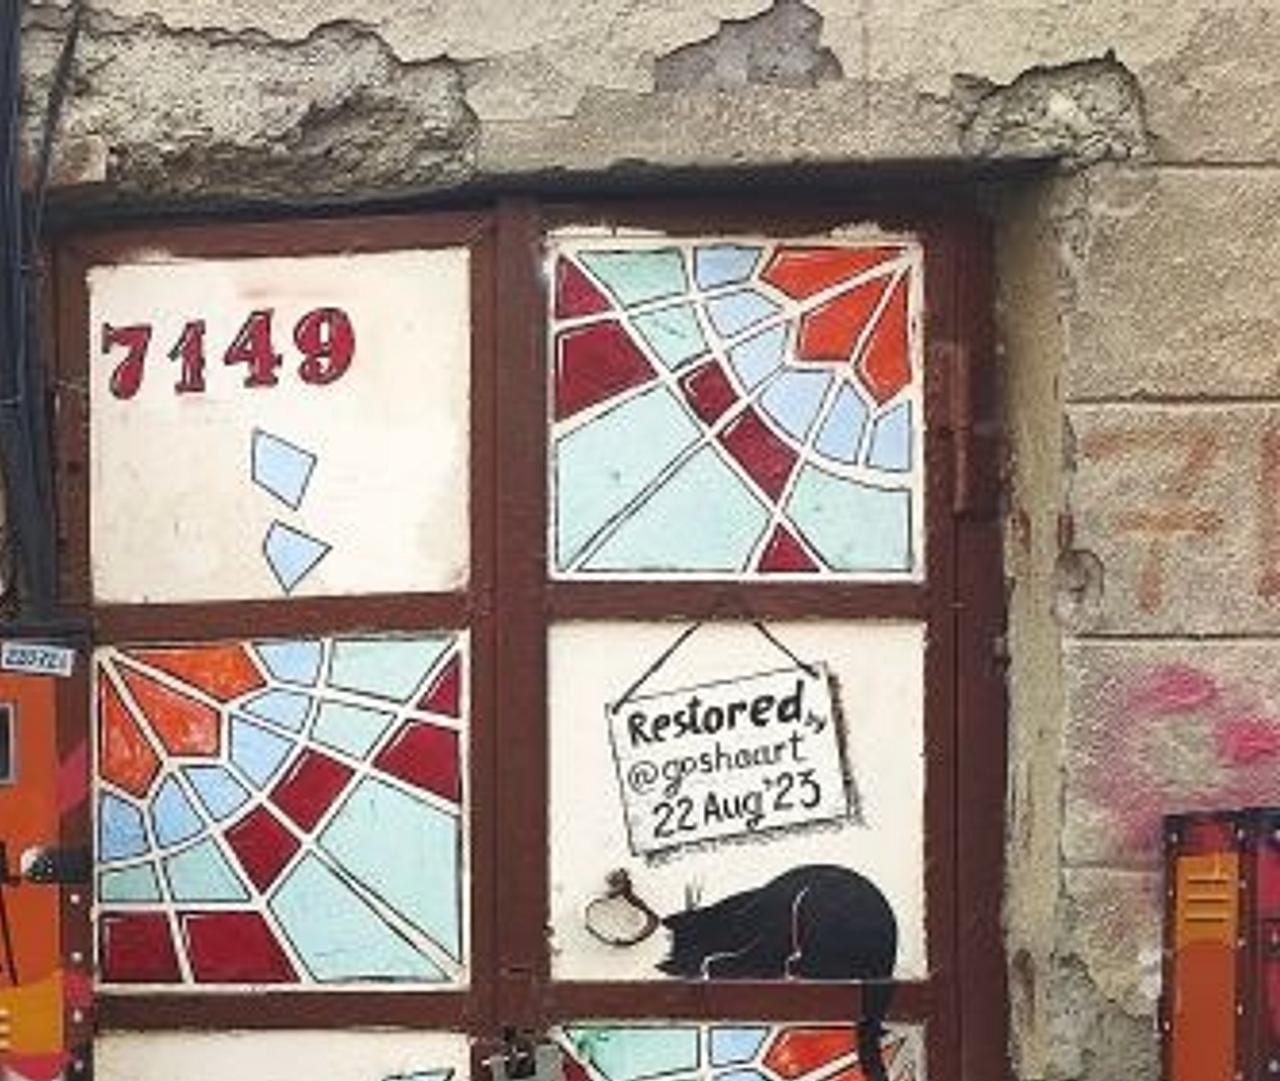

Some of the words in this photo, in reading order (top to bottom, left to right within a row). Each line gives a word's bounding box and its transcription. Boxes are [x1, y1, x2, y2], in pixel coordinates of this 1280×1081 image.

[101, 306, 356, 400] 7149
[627, 680, 804, 747] Restored
[627, 730, 807, 799] @goshaart
[652, 796, 697, 838] 22
